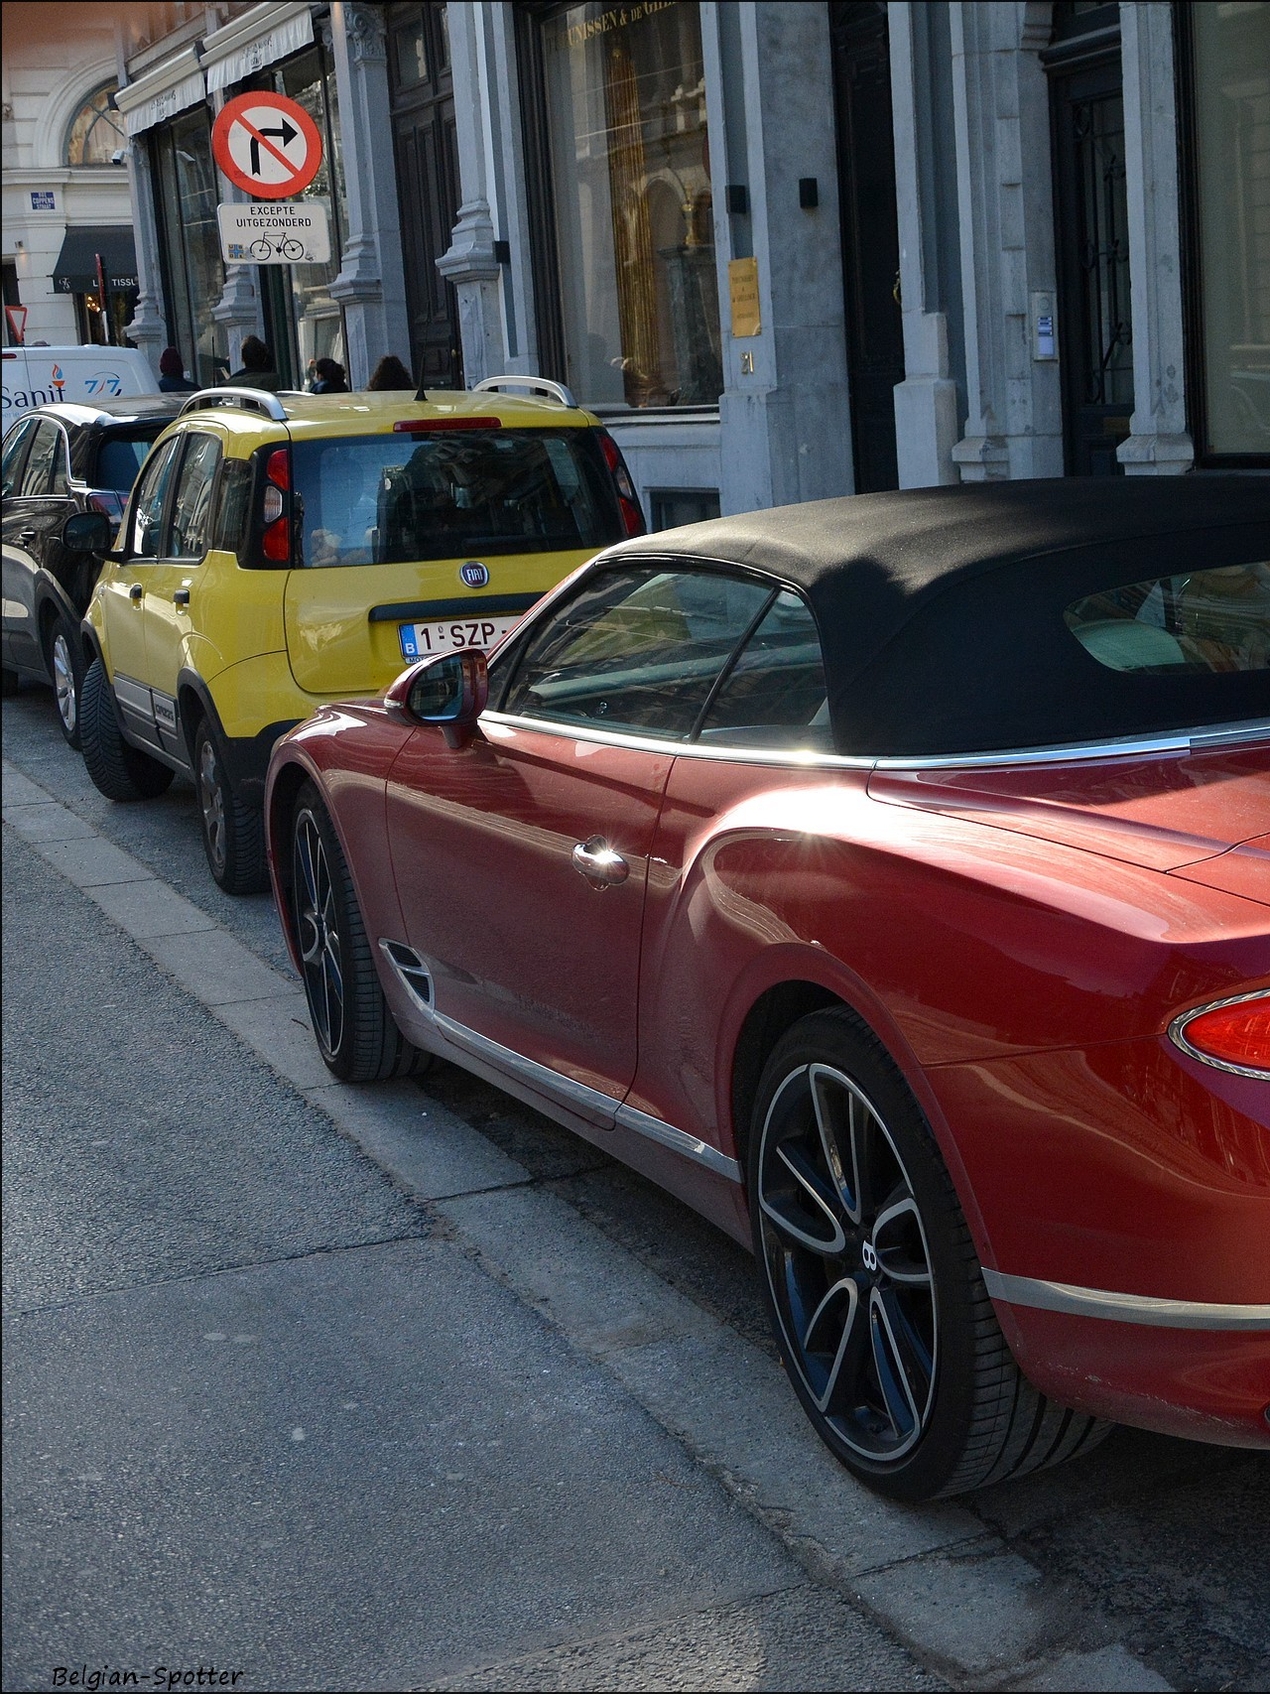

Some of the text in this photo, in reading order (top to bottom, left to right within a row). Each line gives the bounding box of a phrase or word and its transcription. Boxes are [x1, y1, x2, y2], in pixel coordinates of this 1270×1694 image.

[250, 206, 296, 215] EXCEPTE
[236, 218, 312, 227] UITGEZONDERD
[466, 568, 483, 581] FIAT
[405, 642, 416, 654] B
